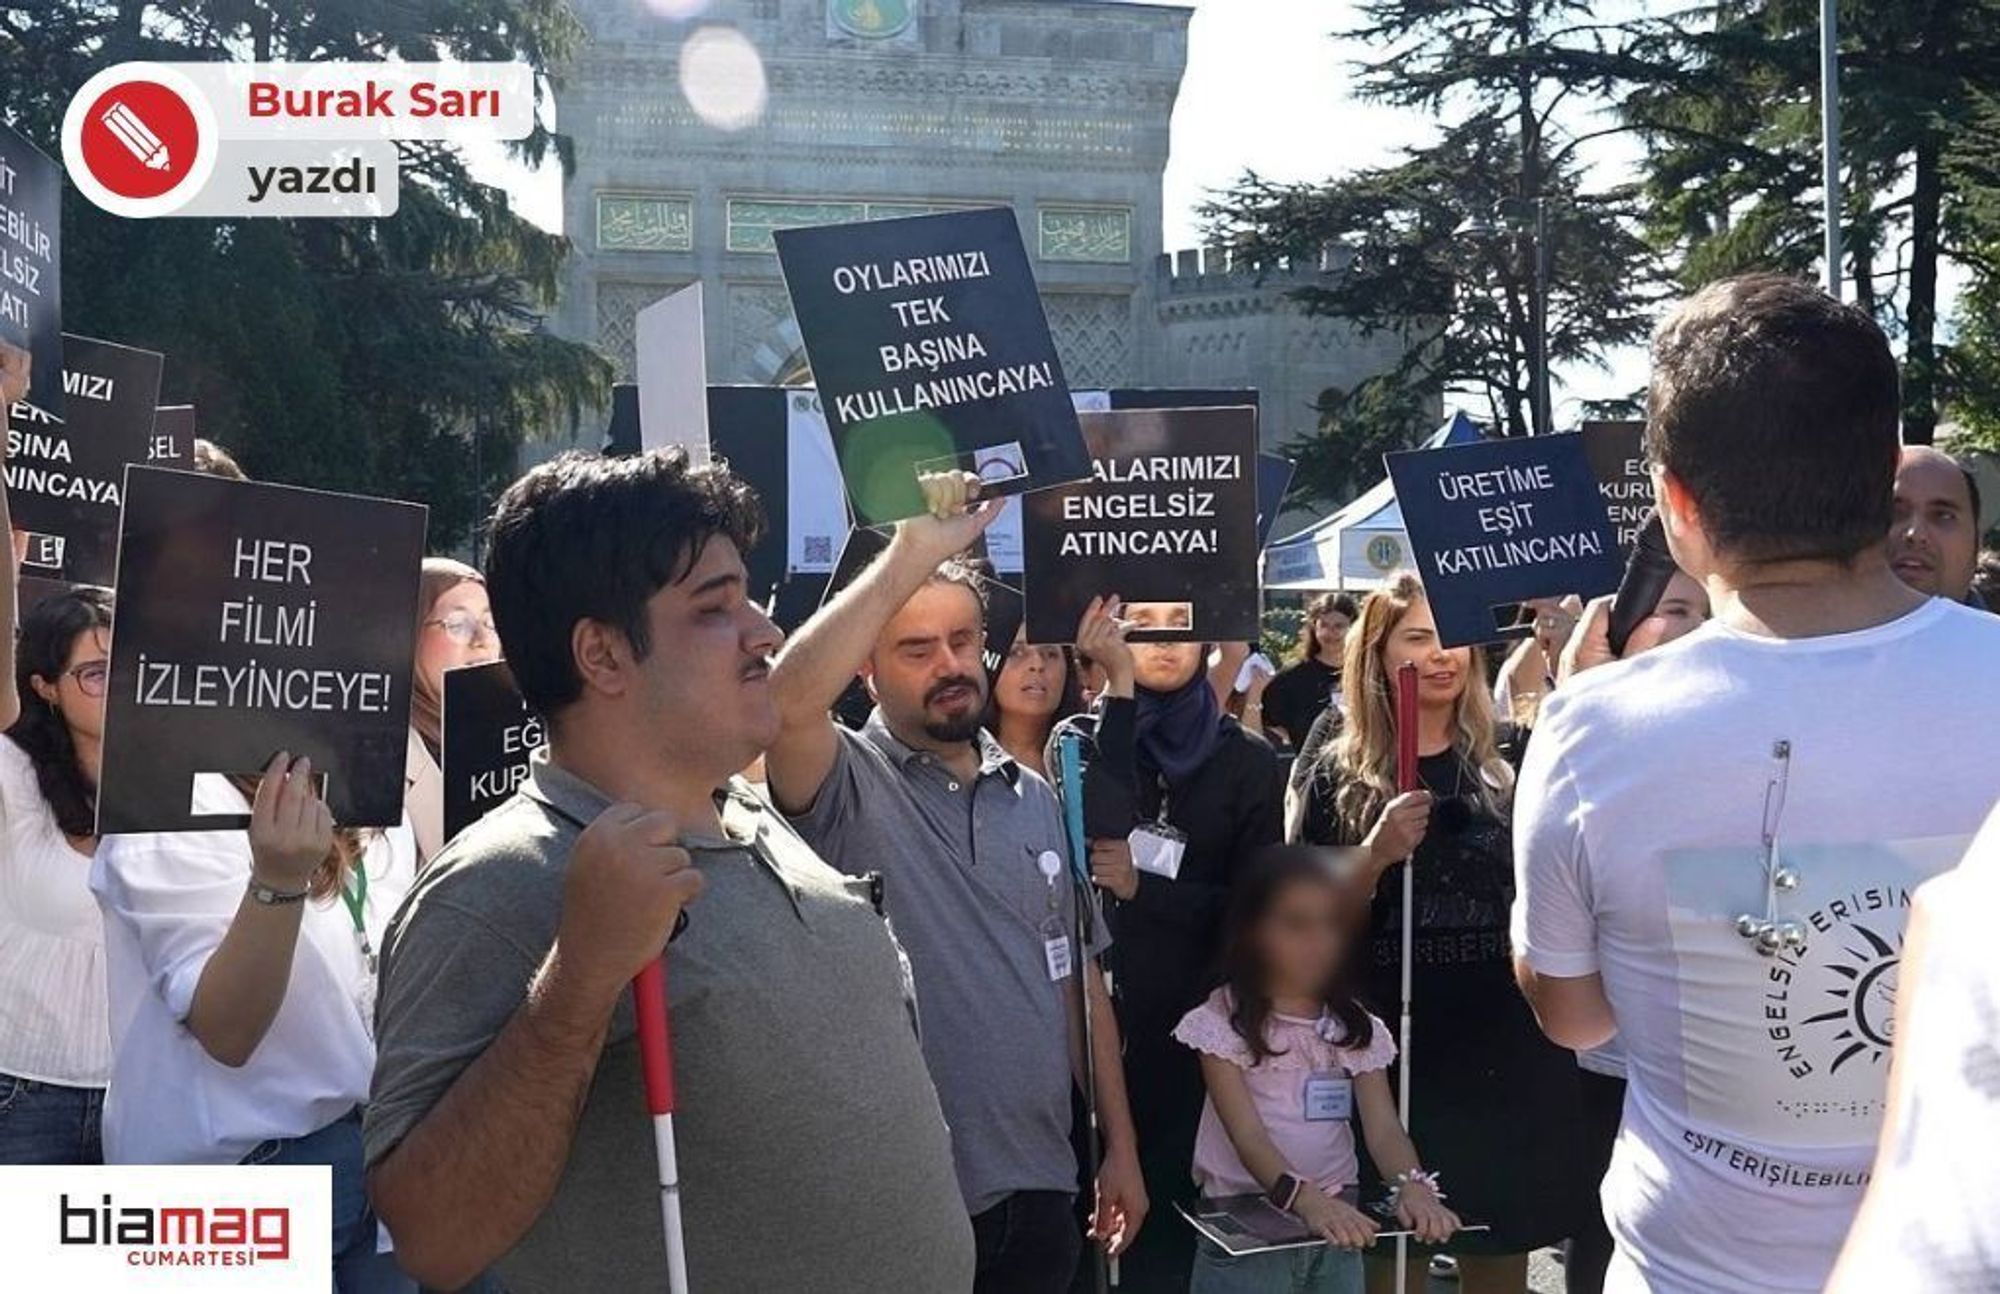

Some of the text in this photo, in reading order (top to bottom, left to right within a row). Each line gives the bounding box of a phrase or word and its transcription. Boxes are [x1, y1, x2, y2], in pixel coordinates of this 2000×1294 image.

[833, 250, 991, 294] OYLARIMIZI
[890, 295, 951, 328] TEK
[880, 332, 987, 373] BAŞINA
[835, 361, 1055, 424] KULLANINCAYA!
[1063, 487, 1215, 520] ENGELSİZ
[1438, 464, 1554, 501] ÜRETİME
[1478, 500, 1534, 536] EŞİT
[233, 537, 312, 585] HER
[1060, 529, 1219, 556] ATINCAYA!
[1435, 530, 1603, 576] KATILINCAYA!
[219, 595, 317, 647] FİLMİ
[135, 653, 391, 712] İZLEYİNCEYE!
